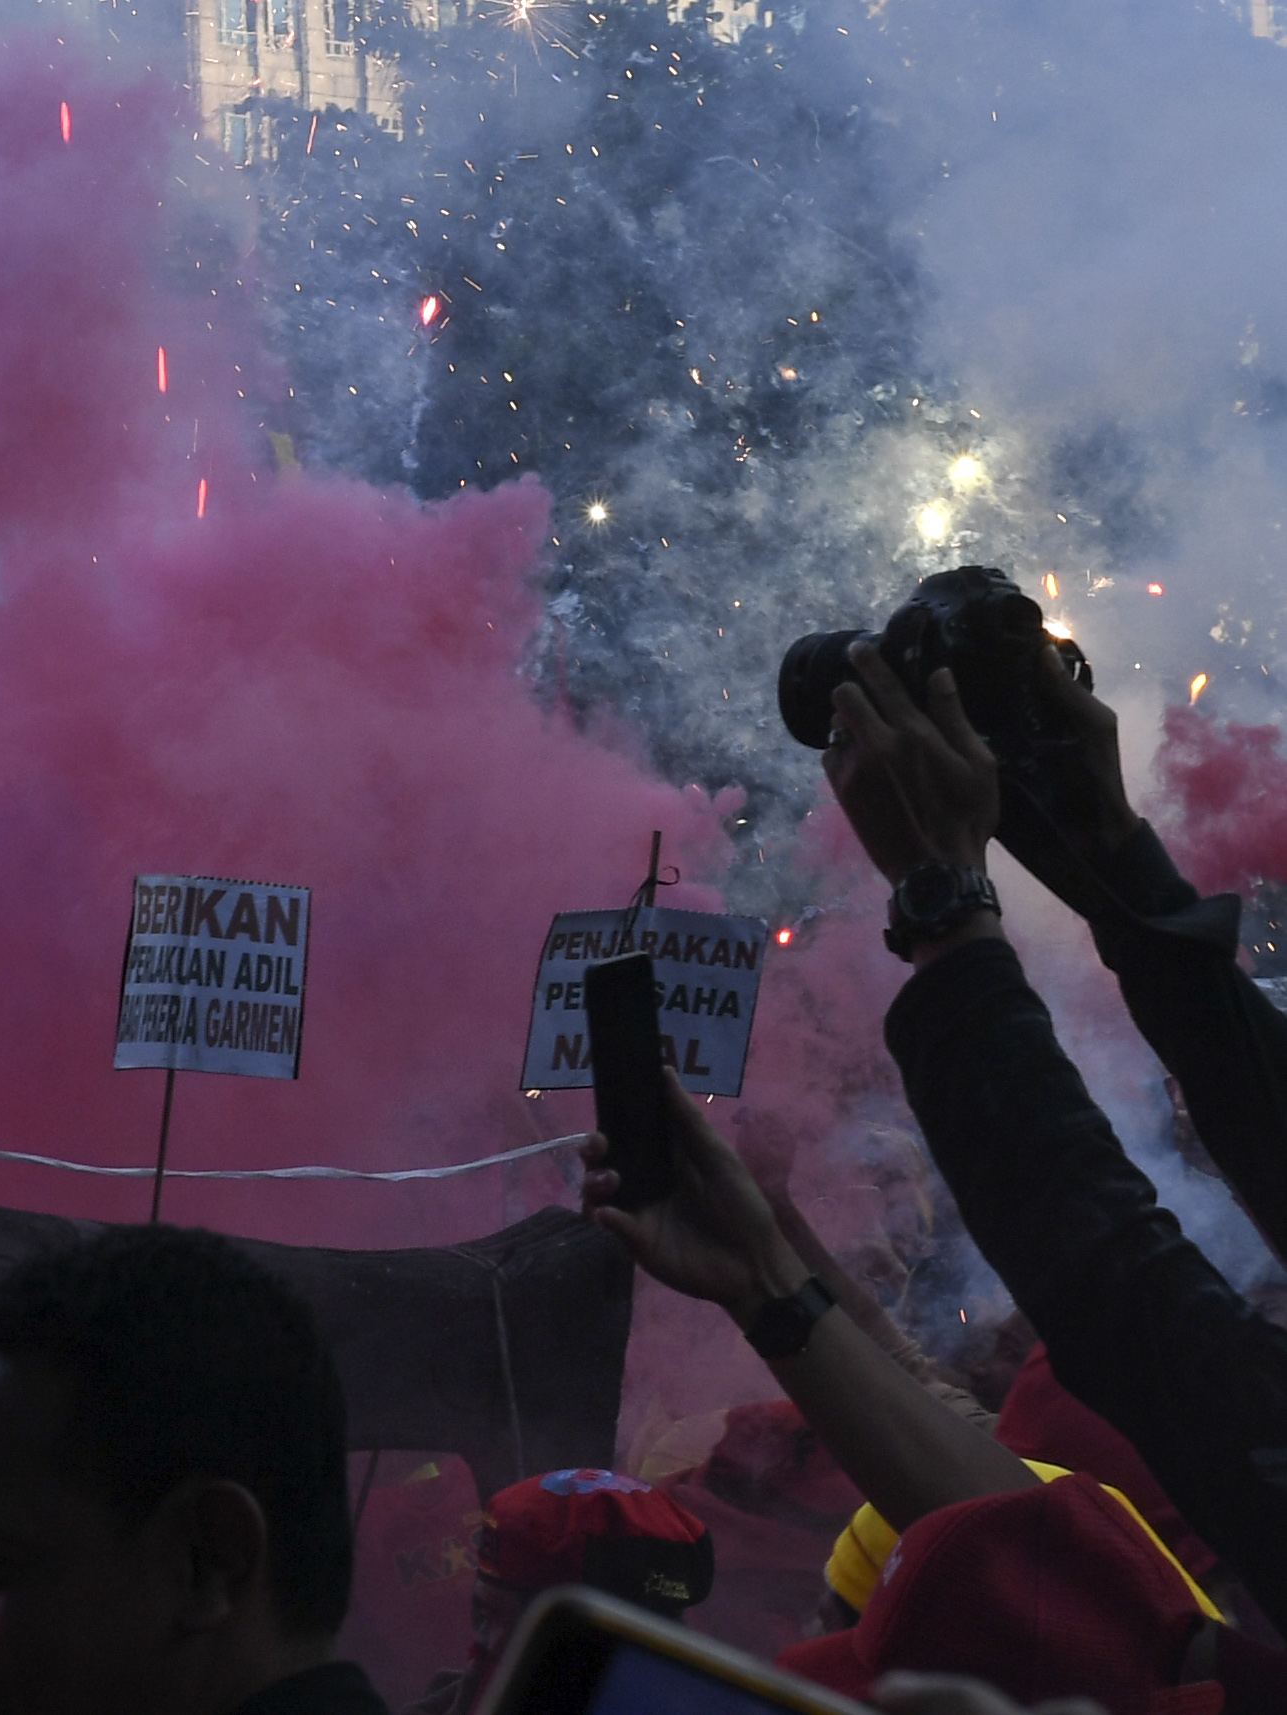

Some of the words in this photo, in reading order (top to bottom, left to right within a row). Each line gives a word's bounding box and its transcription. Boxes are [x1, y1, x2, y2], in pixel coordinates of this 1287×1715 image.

[136, 885, 300, 946] BERIKAN
[234, 953, 299, 995] ADIL
[548, 930, 759, 970] PENJARAKAN
[205, 998, 297, 1054] GARMEN
